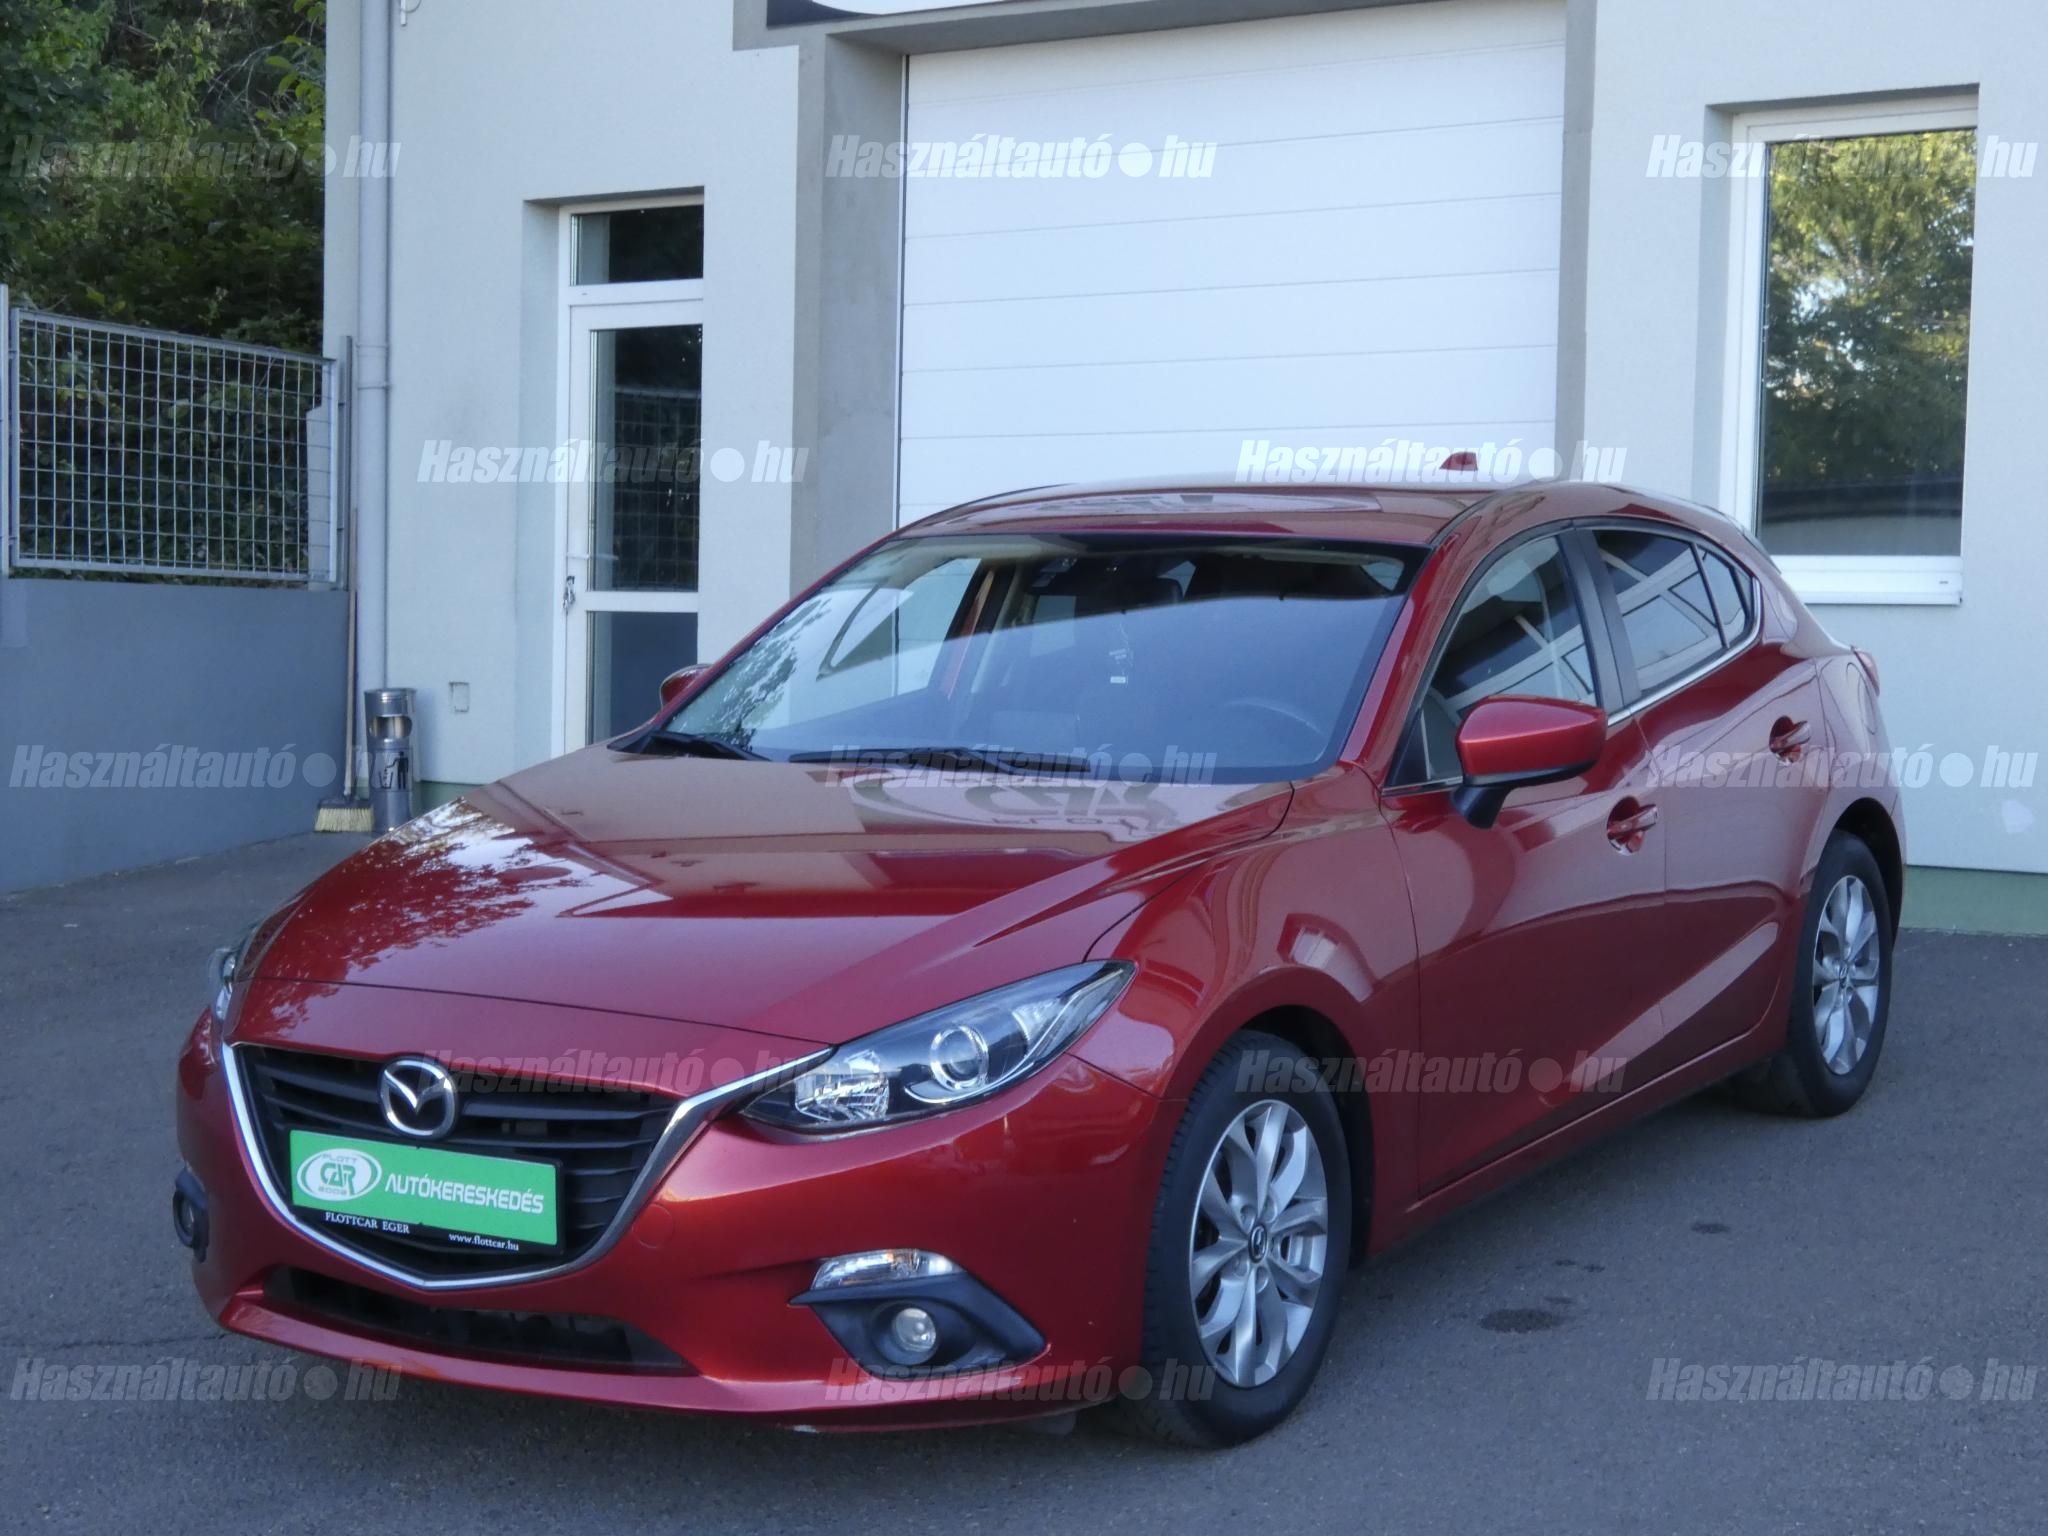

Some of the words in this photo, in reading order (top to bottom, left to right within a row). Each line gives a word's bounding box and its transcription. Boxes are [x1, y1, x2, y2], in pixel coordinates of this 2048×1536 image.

[384, 1173, 544, 1215] AUTÓKERESKEDÉS
[325, 1211, 378, 1230] FLOTTCAR
[382, 1220, 410, 1235] EGER
[448, 1232, 520, 1252] www.flottcar.hu
